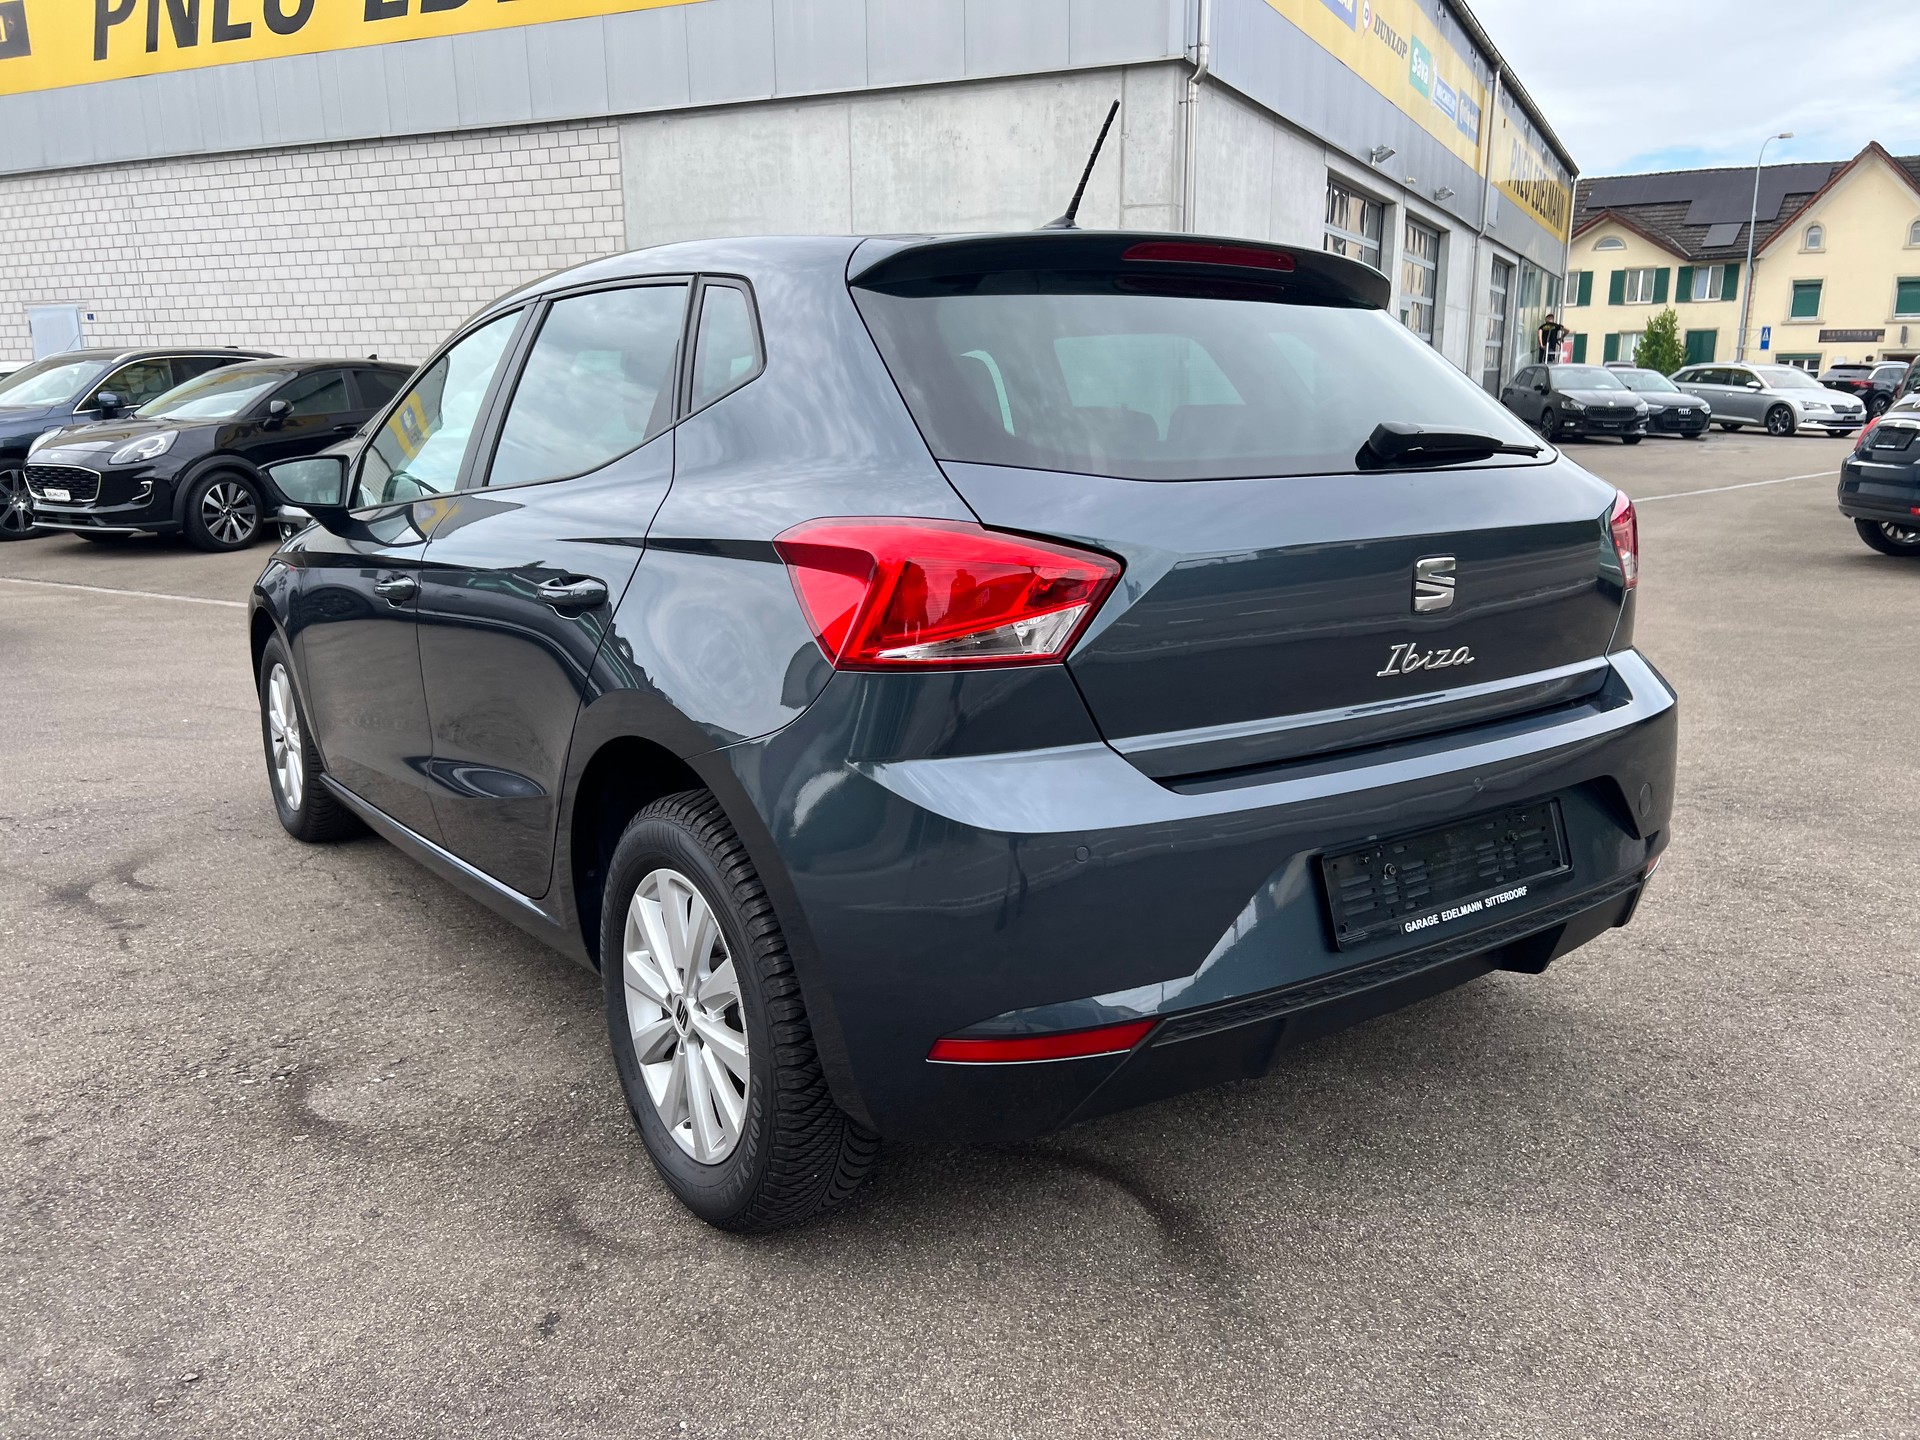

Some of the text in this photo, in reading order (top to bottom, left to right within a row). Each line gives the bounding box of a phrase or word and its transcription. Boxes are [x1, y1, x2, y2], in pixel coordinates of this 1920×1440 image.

[1373, 13, 1408, 60] DUNLOP
[1412, 47, 1429, 85] Sava
[1508, 138, 1566, 233] PNEU EDELMANN
[1376, 642, 1475, 677] Ibiza
[1404, 886, 1528, 933] GARAGE EDELMANN SITTERDORF
